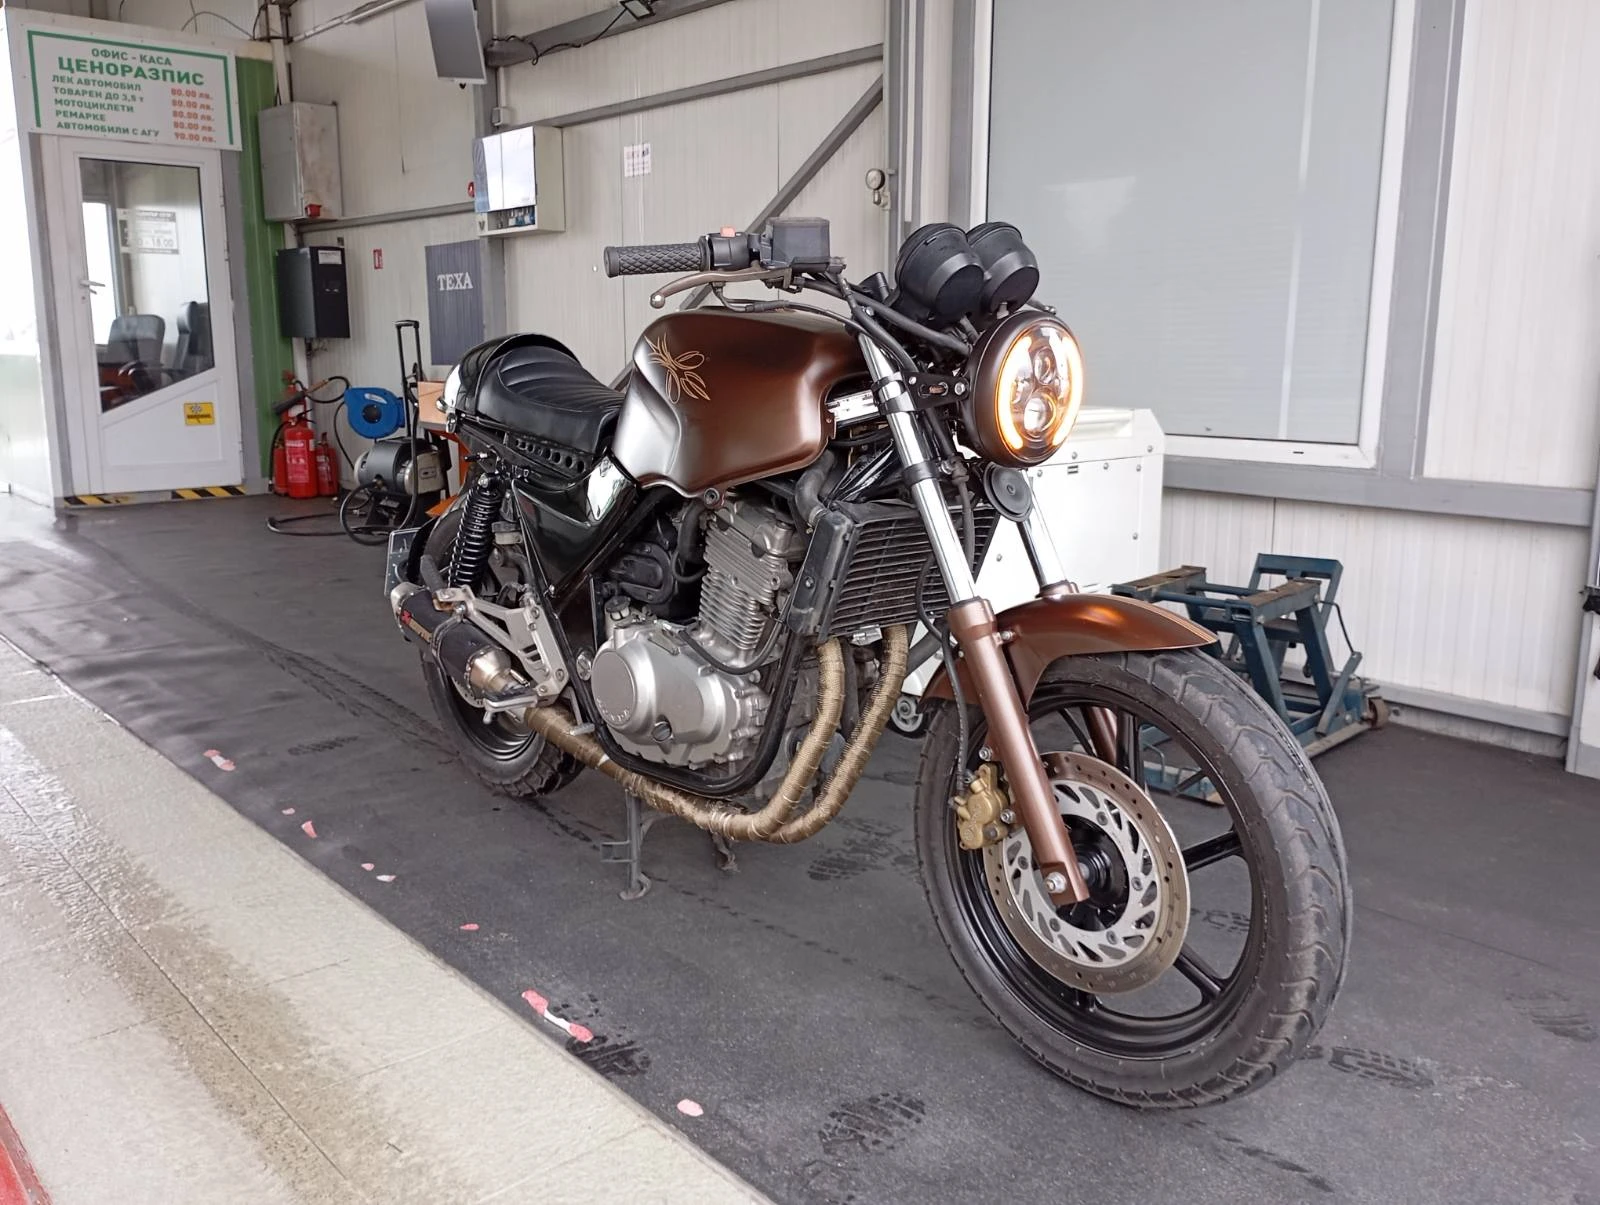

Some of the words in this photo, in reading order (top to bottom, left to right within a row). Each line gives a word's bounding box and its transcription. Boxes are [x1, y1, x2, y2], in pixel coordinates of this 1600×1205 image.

[92, 48, 128, 60] ОФИС
[140, 54, 172, 66] КАСА
[58, 56, 204, 86] ЦЕНОРАЗПИС
[52, 74, 74, 84] ЛЕК
[77, 77, 141, 91] АВТОМОБИЛ
[53, 87, 102, 98] ТОВАРЕН
[105, 92, 119, 101] ДО
[54, 99, 134, 113] МОТОЦИКЛЕТИ
[56, 110, 106, 121] РЕМАРКЕ
[57, 122, 129, 135] АВТОМОБИЛИ
[140, 129, 159, 137] АГУ
[437, 272, 473, 291] TEXA
